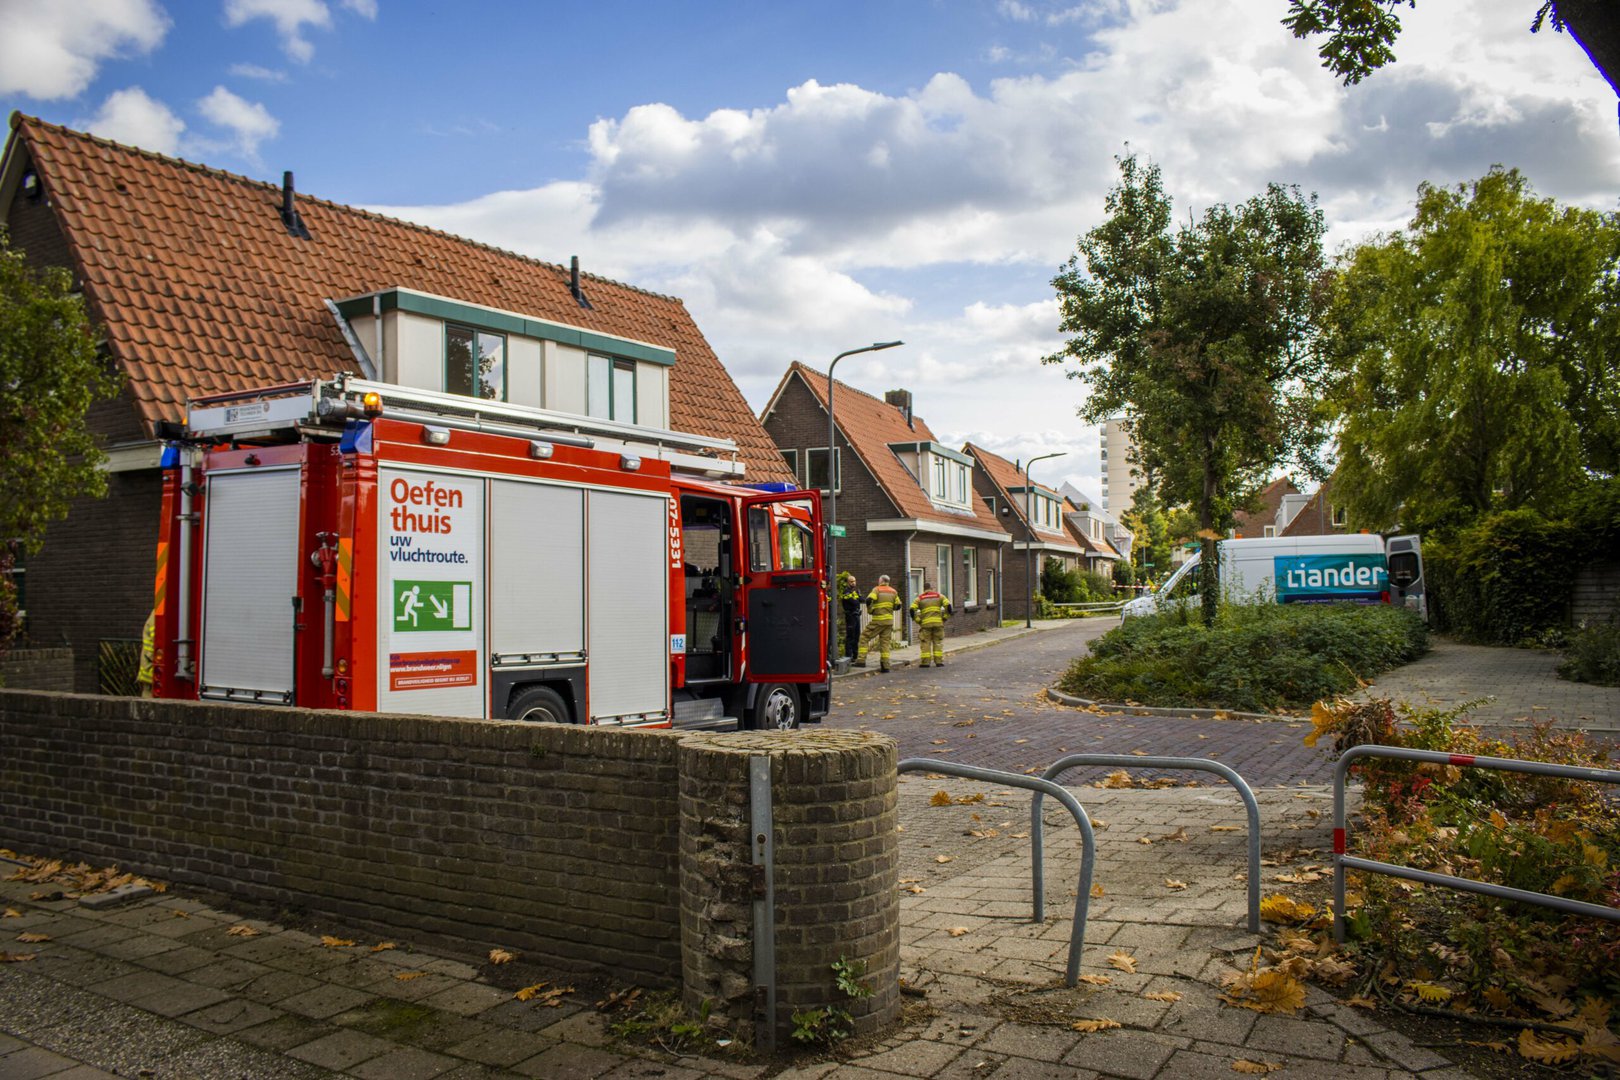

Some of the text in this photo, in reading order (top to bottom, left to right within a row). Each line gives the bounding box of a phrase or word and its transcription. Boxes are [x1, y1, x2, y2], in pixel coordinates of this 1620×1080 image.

[390, 478, 463, 508] Oefen
[390, 505, 452, 534] thuis
[390, 535, 412, 547] uw
[669, 498, 682, 569] 07-5331
[390, 547, 469, 564] vluchtroute.
[1287, 561, 1385, 588] Liander
[672, 638, 683, 649] 112
